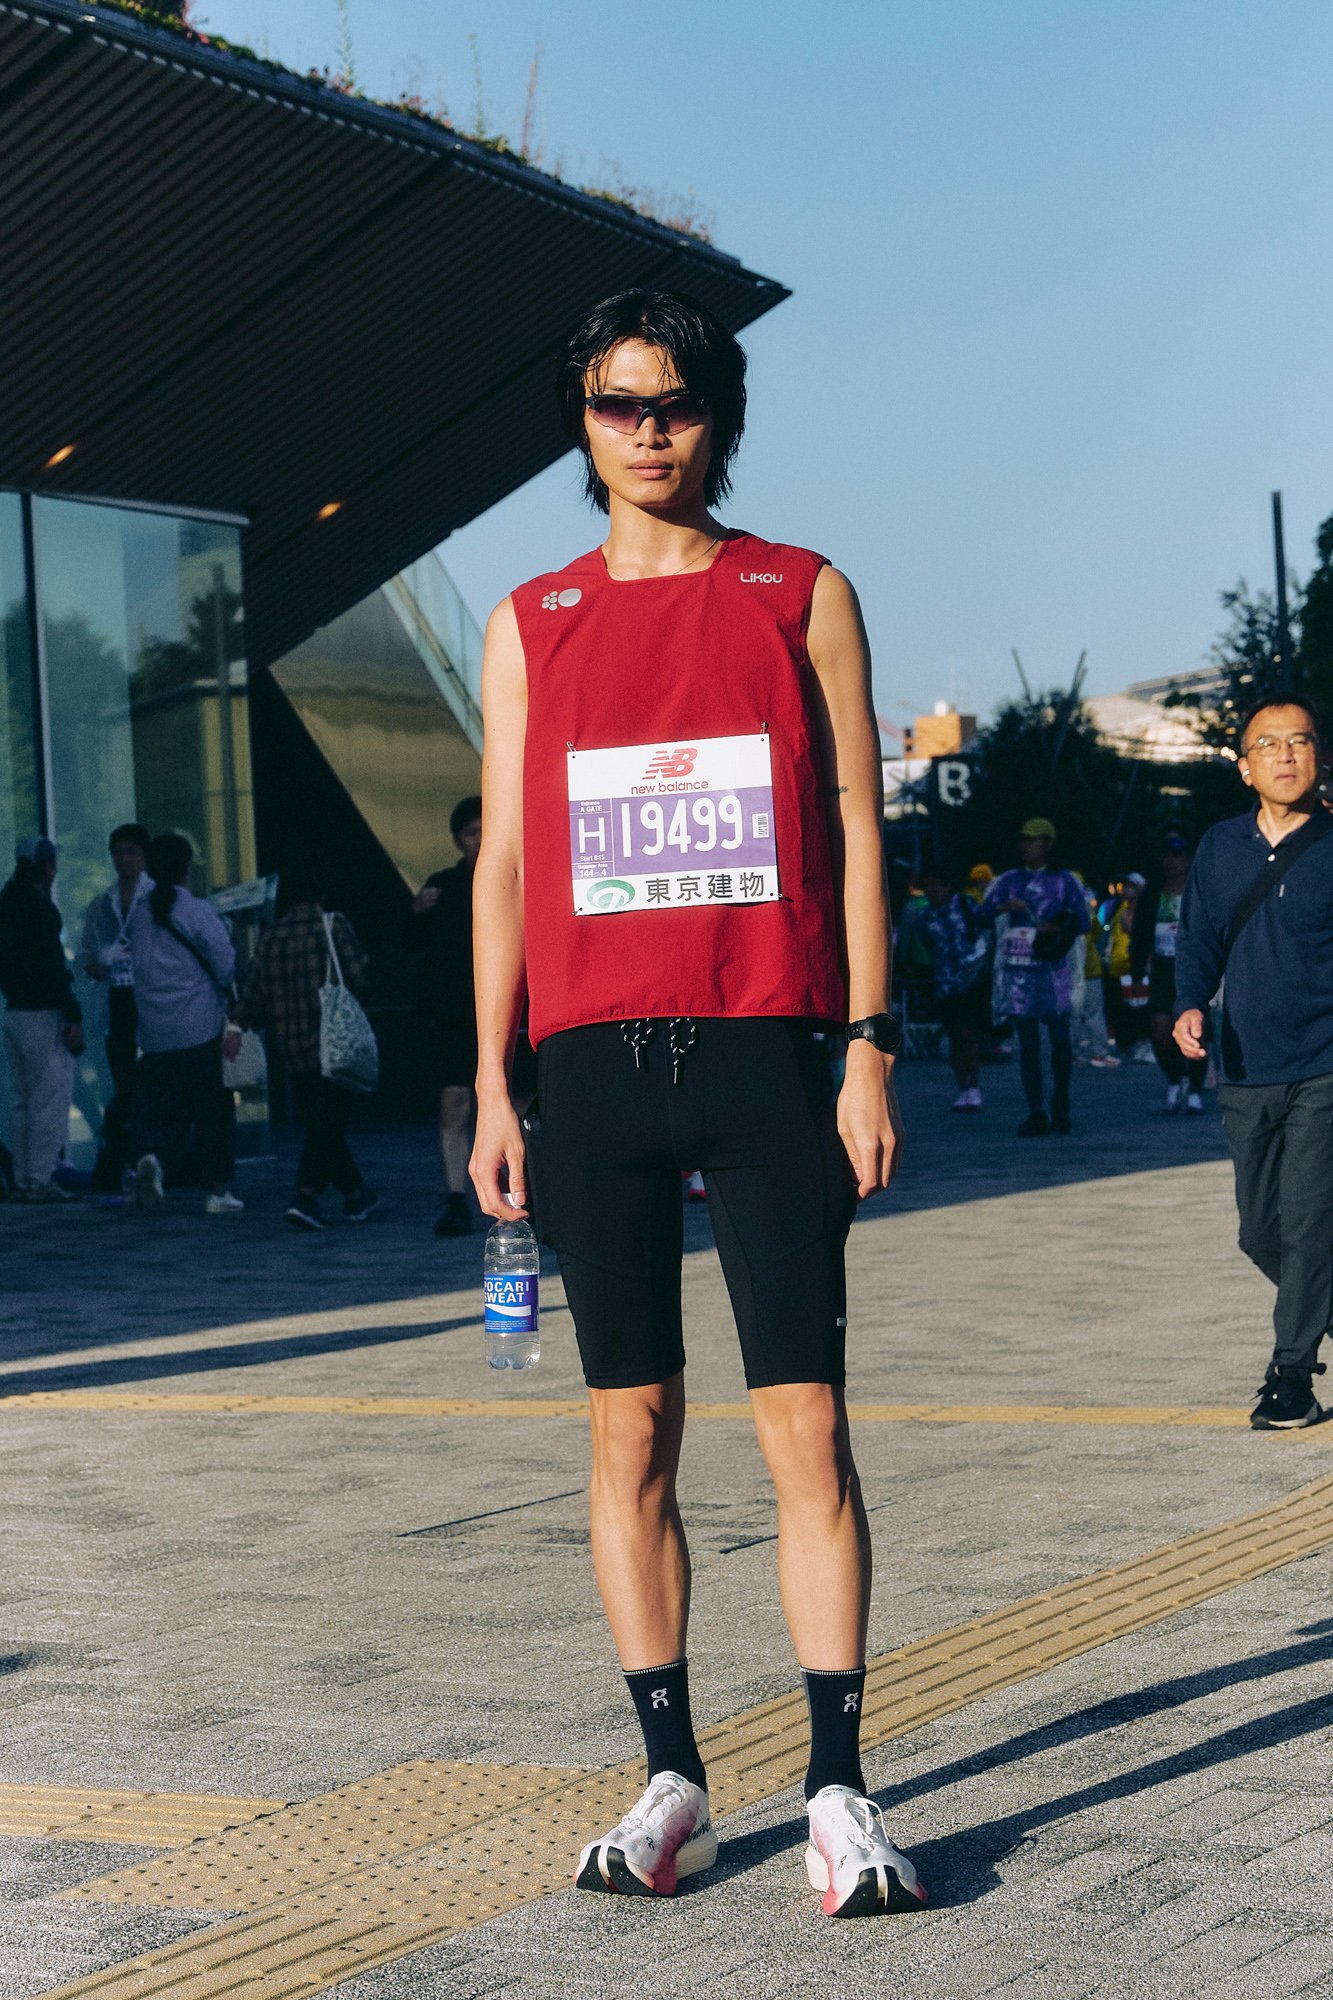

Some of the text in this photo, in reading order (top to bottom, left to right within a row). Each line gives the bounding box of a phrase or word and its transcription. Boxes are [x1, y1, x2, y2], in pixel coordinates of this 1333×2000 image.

[740, 572, 783, 583] LIKOU
[631, 781, 709, 794] new balance
[938, 761, 971, 807] B
[586, 805, 602, 813] GATE
[578, 817, 606, 854] H
[621, 795, 744, 858] 19499
[645, 872, 765, 904] 東京建物
